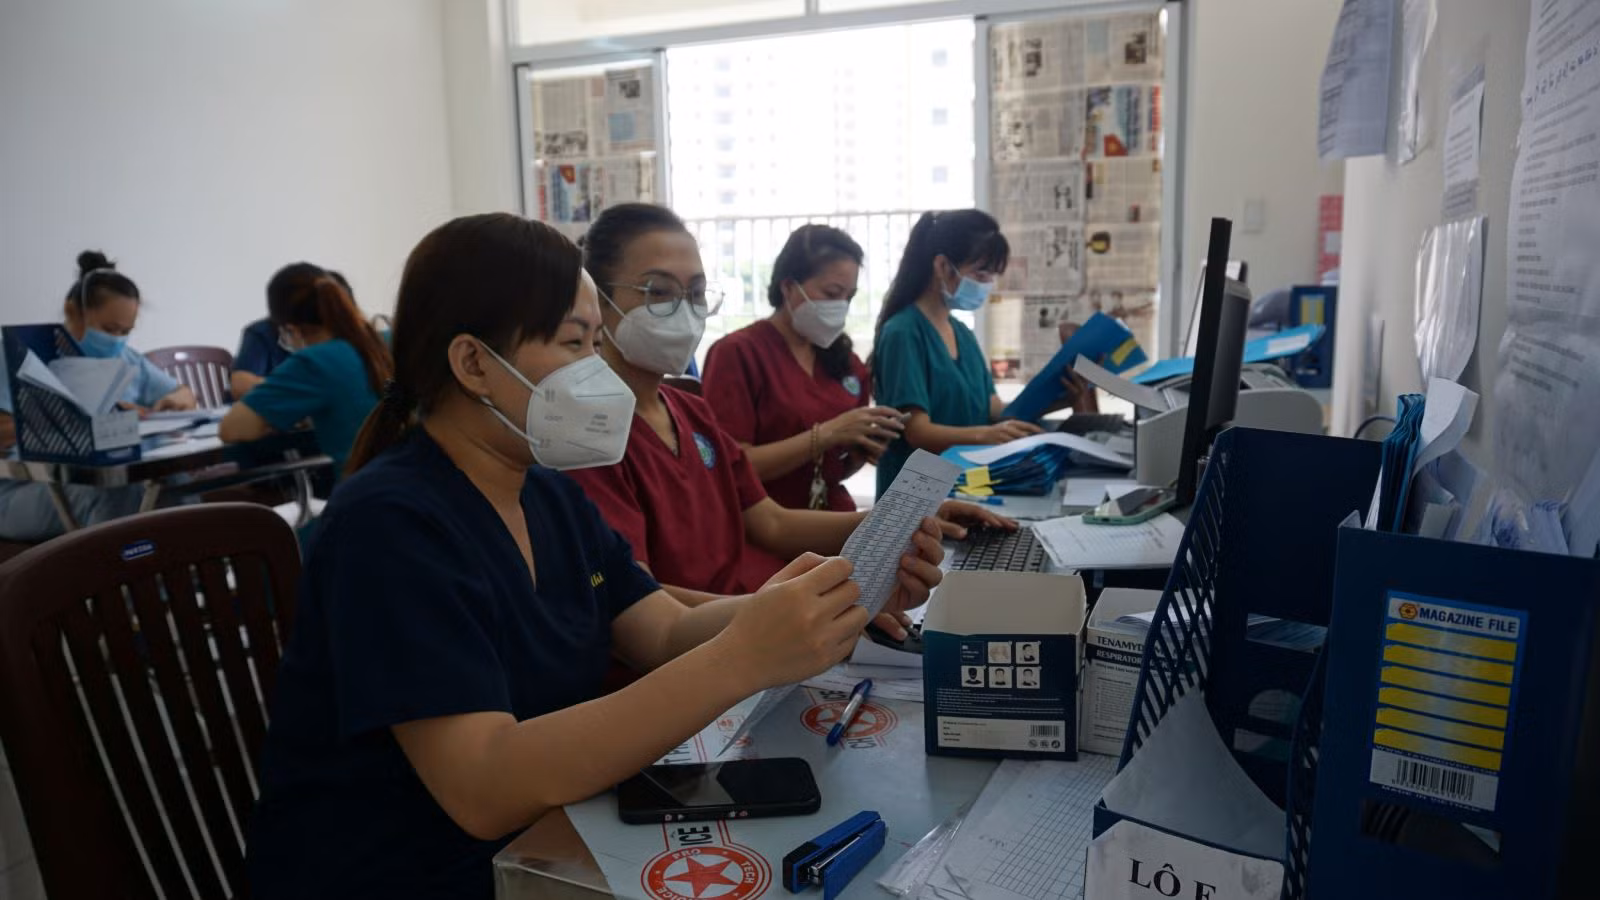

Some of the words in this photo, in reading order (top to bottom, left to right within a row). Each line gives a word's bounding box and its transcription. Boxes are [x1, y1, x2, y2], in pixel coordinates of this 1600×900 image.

[1418, 606, 1484, 630] MAGAZINE
[1488, 617, 1517, 634] FILE
[1128, 857, 1181, 897] LÔ
